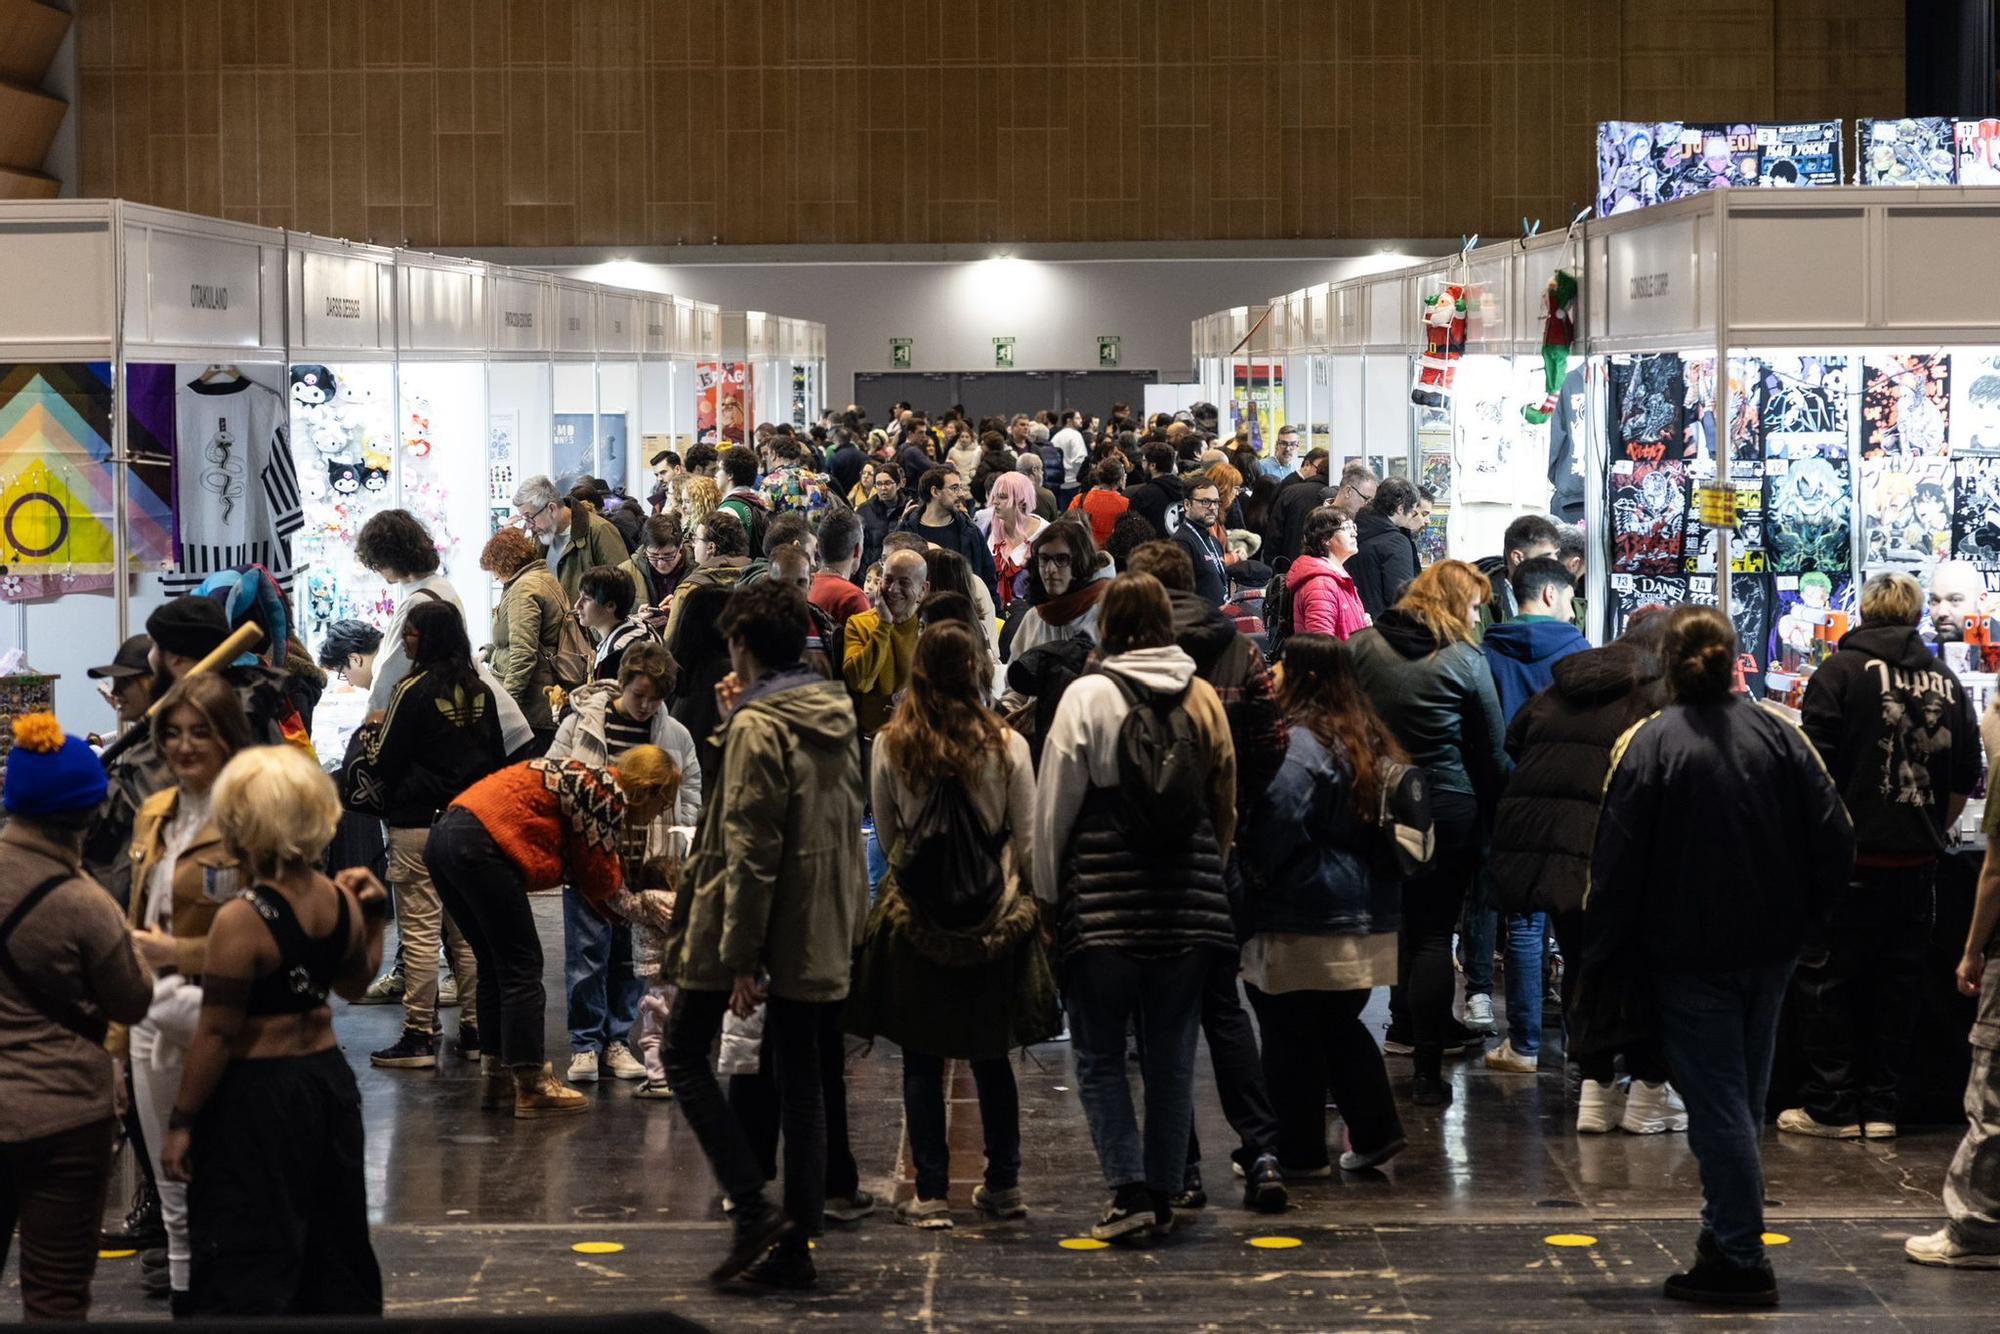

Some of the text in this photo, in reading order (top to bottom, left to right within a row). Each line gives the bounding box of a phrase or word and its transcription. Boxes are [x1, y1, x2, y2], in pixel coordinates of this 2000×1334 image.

[191, 284, 228, 310] OTAKULAND
[1616, 576, 1628, 586] 73
[1695, 578, 1706, 590] 74
[1642, 578, 1687, 603] DANIEL
